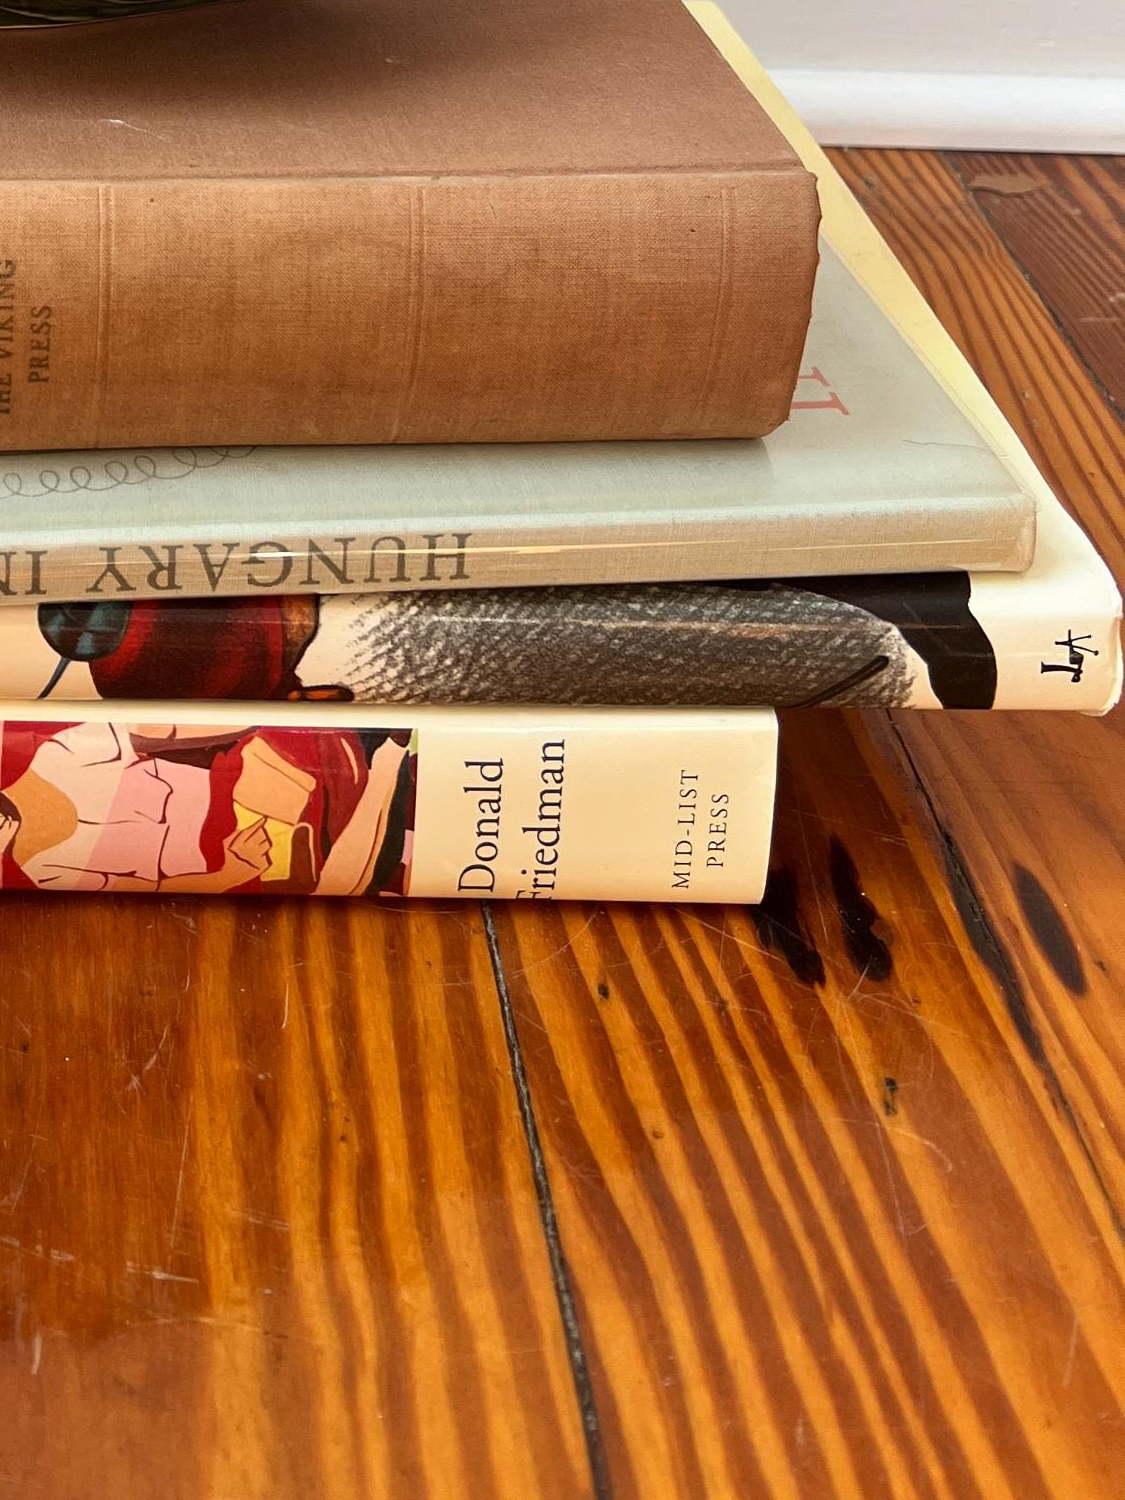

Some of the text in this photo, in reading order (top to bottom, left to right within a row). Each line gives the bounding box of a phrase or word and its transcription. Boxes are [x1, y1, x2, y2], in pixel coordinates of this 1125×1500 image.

[28, 304, 53, 385] PRESS
[85, 531, 474, 593] HUNGARY
[457, 756, 504, 893] Donald
[671, 769, 699, 889] MID-LIST
[706, 792, 730, 868] PRESS
